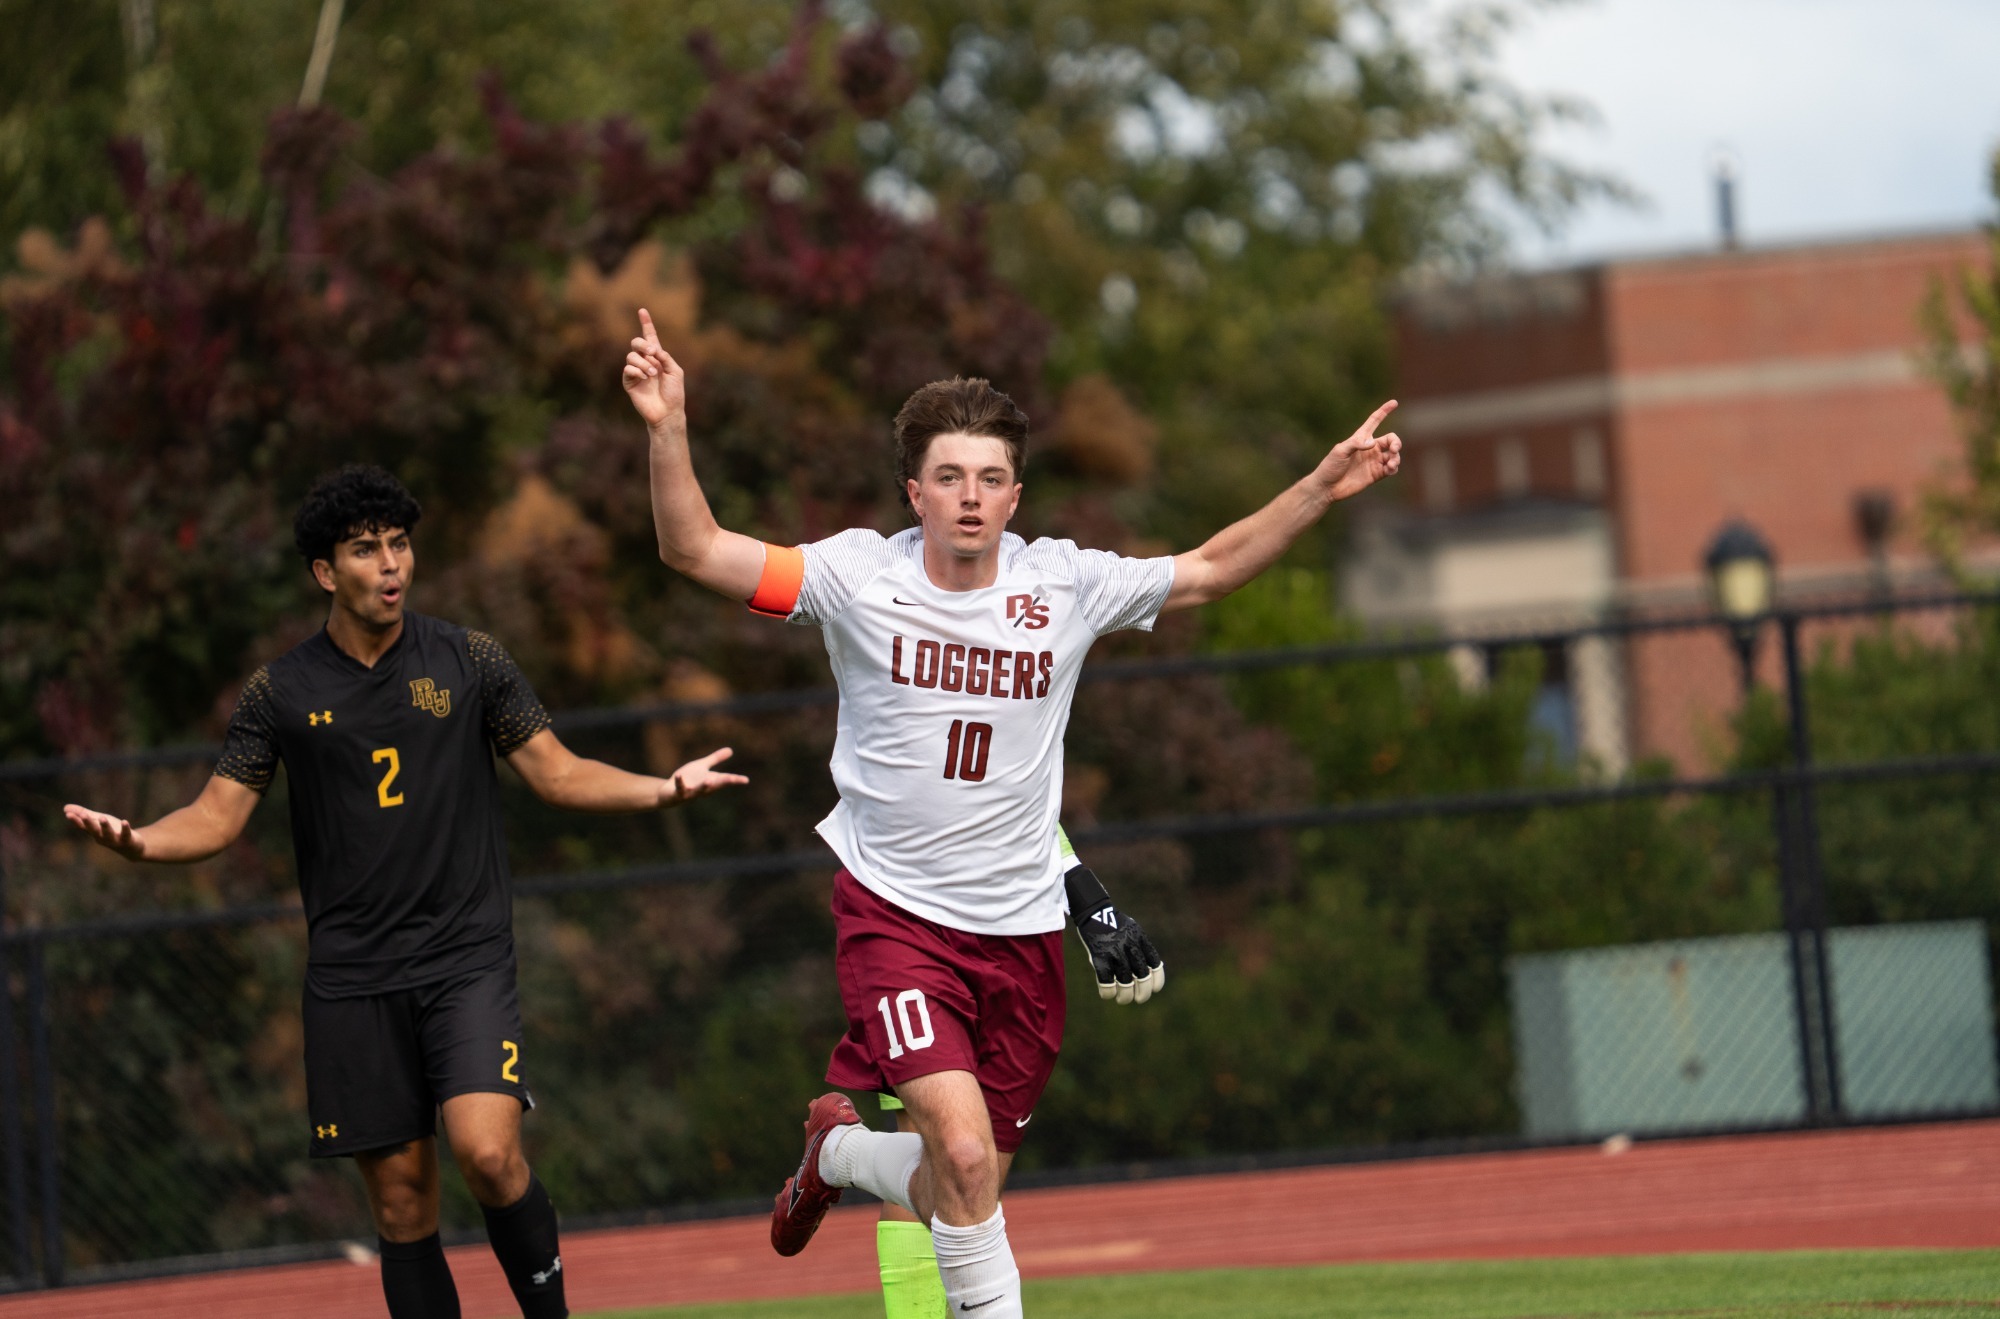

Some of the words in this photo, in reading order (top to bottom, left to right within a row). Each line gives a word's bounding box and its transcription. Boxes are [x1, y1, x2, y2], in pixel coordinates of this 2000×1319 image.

[892, 636, 1053, 699] LOGGERS
[372, 747, 404, 808] 2
[943, 719, 993, 782] 10
[878, 988, 935, 1060] 10
[502, 1040, 519, 1084] 2
